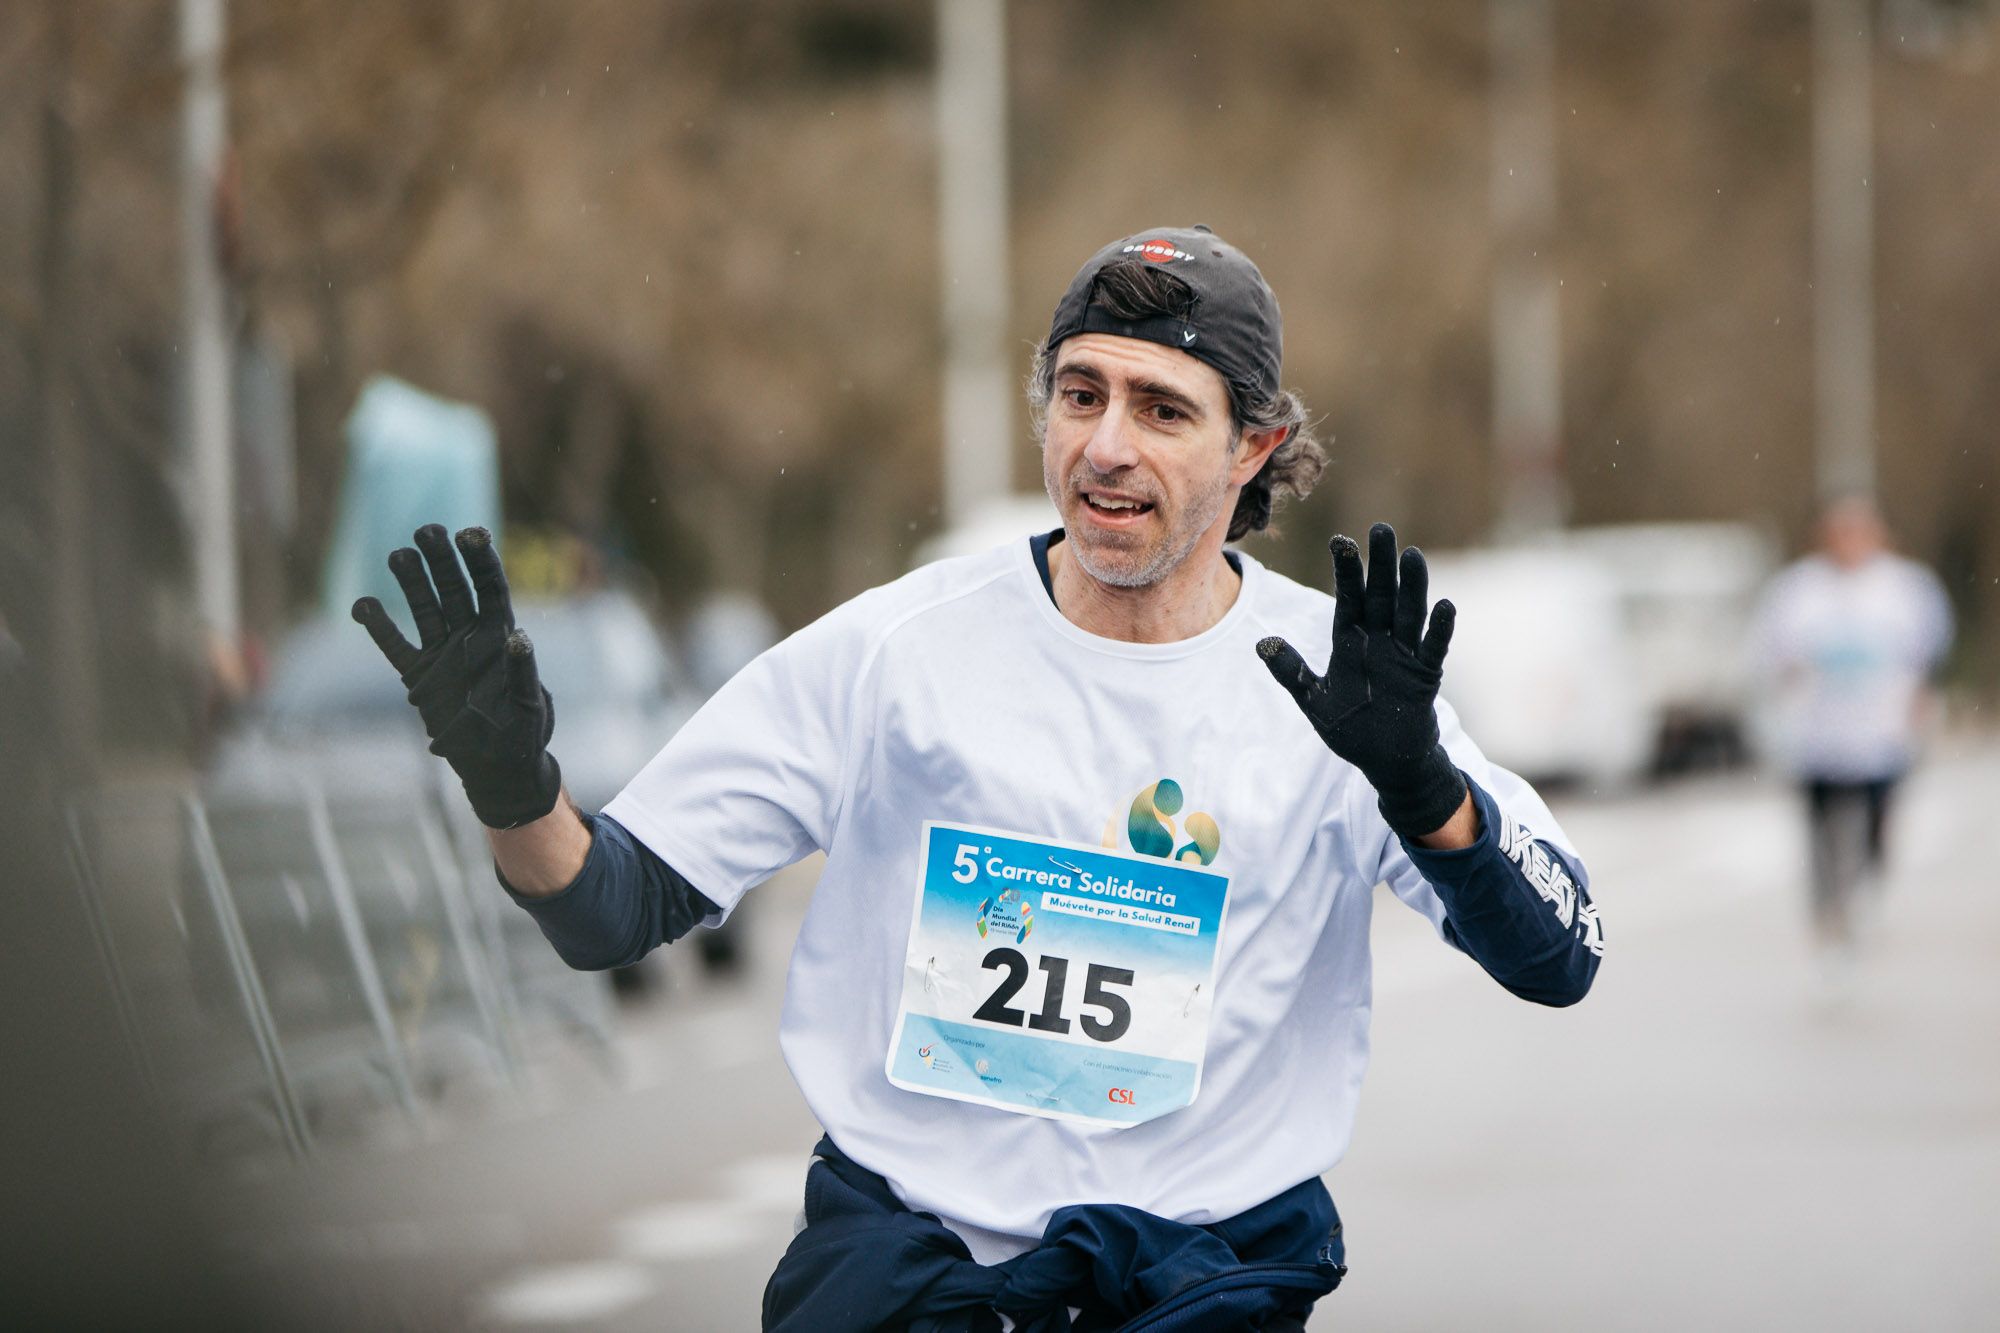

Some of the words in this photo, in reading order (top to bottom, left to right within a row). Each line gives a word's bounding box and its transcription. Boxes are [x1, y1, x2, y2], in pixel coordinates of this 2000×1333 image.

[986, 857, 1072, 889] Carrera
[1077, 872, 1177, 908] Solidaria
[991, 913, 1017, 923] Mundial
[1049, 897, 1095, 912] Muévete
[1097, 908, 1116, 917] por
[1119, 909, 1128, 919] la
[1131, 911, 1161, 925] Salud
[1164, 917, 1195, 930] Renal
[973, 947, 1135, 1042] 215
[1108, 1087, 1136, 1105] CSL
